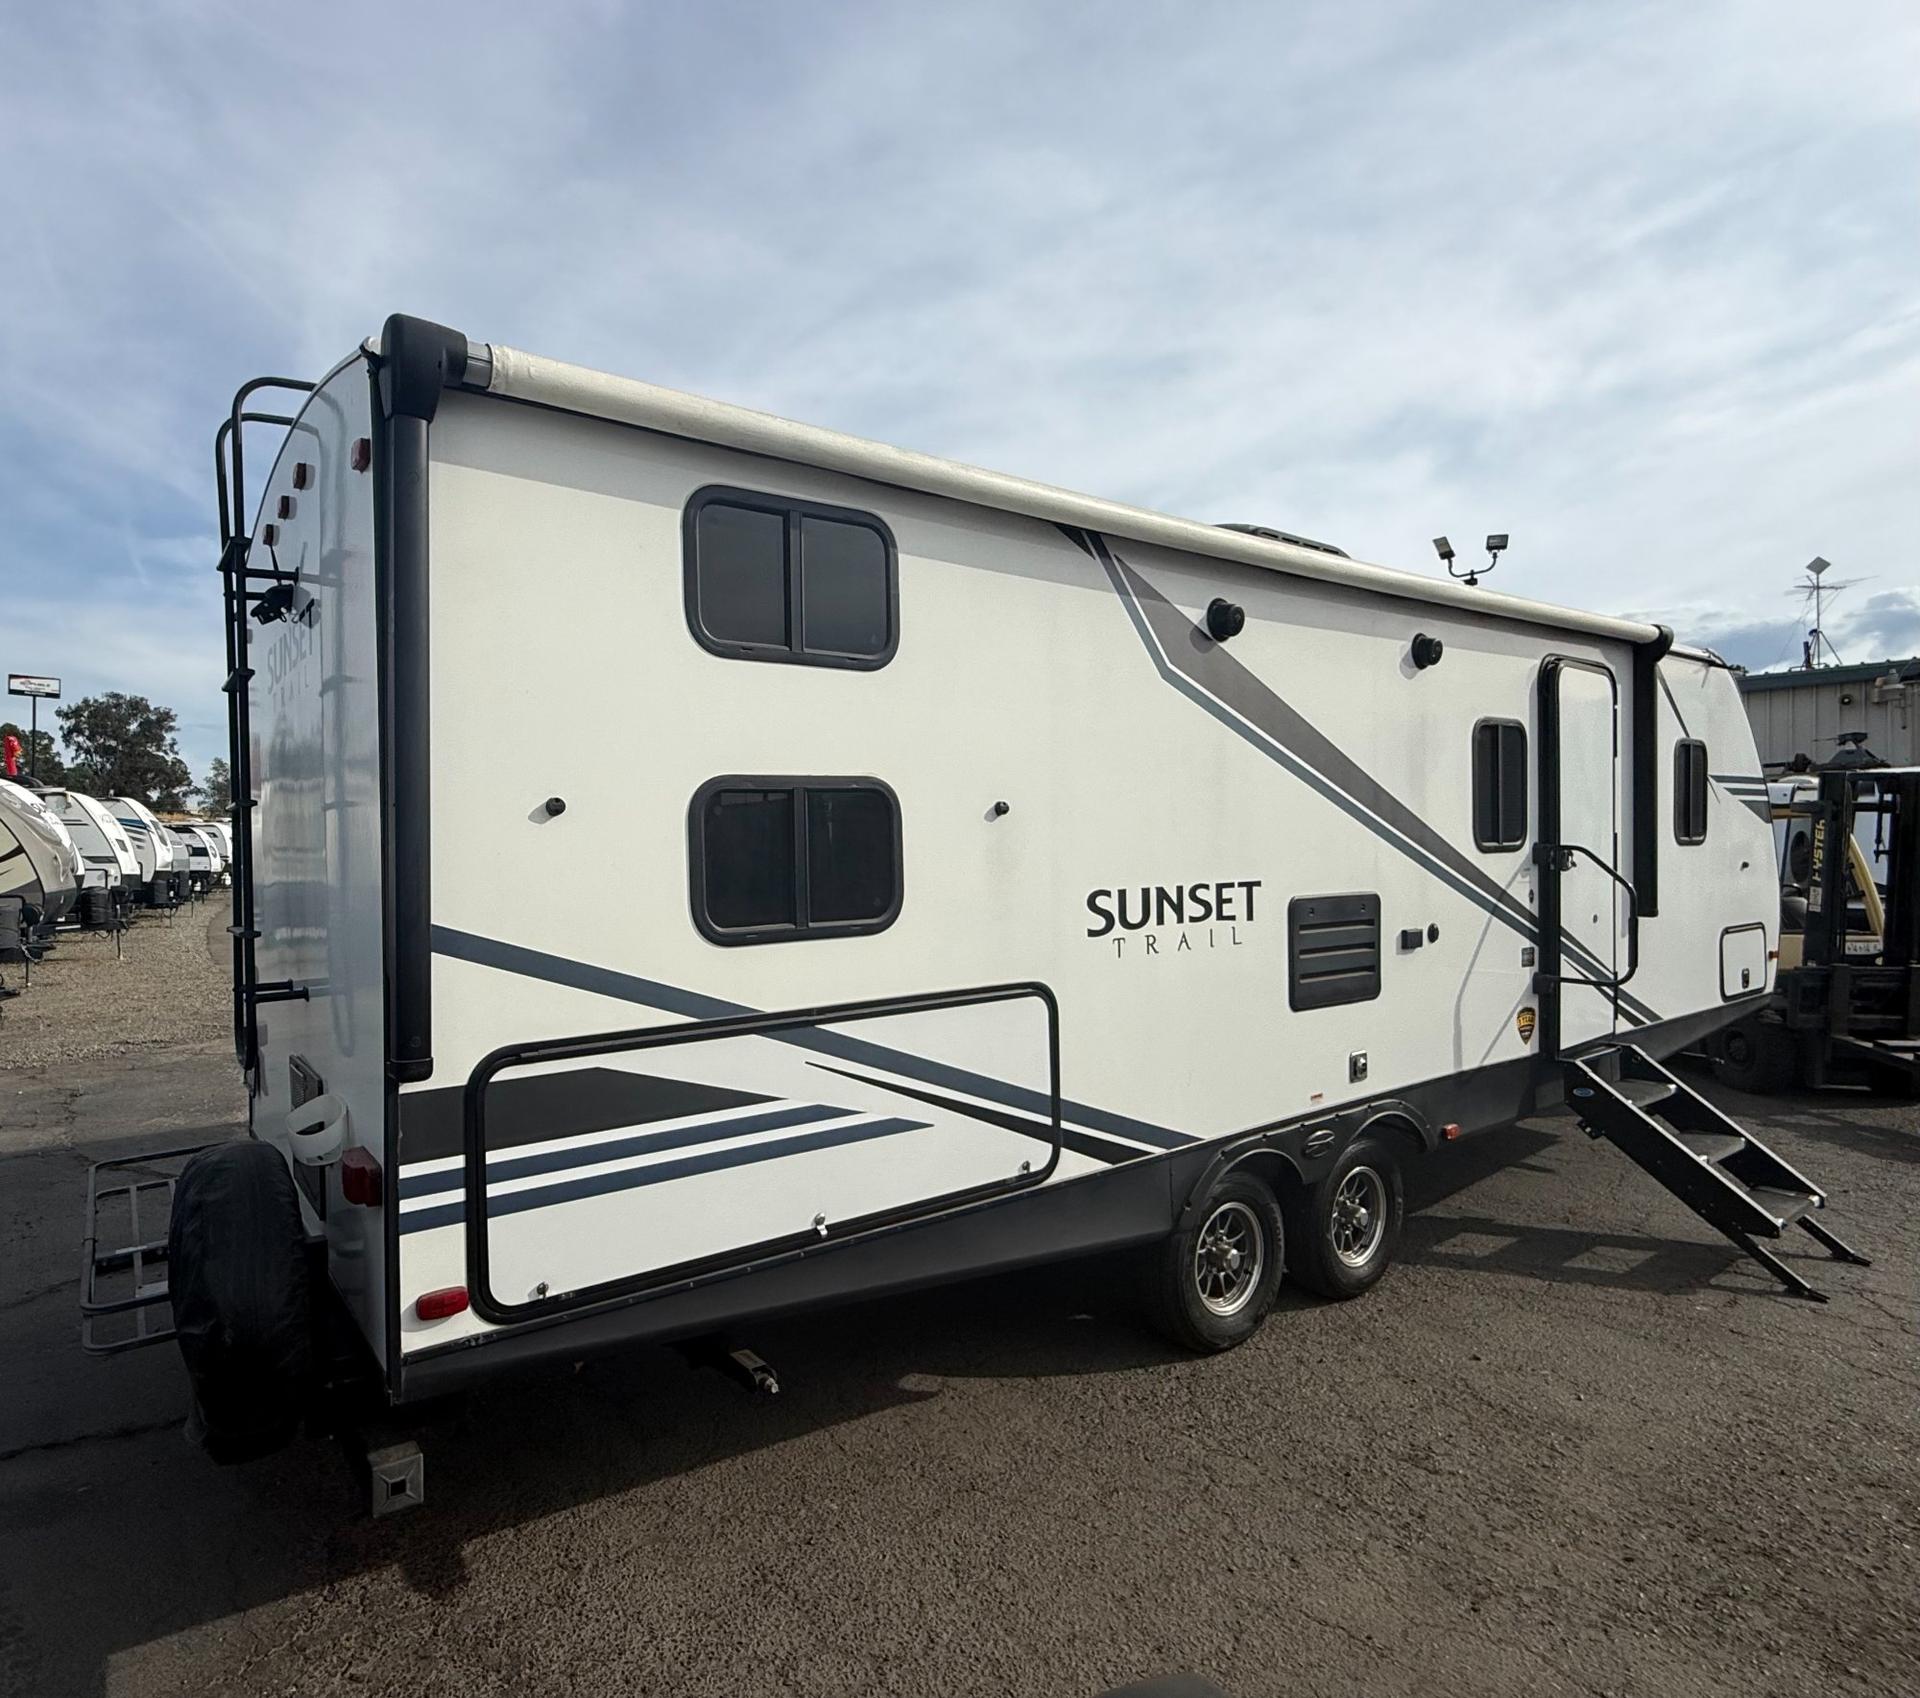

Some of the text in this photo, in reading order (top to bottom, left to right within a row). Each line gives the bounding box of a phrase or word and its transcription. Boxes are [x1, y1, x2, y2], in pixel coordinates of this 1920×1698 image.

[267, 599, 315, 695] SUNSET
[1086, 880, 1262, 938] SUNSET
[1112, 925, 1243, 959] TRAIL
